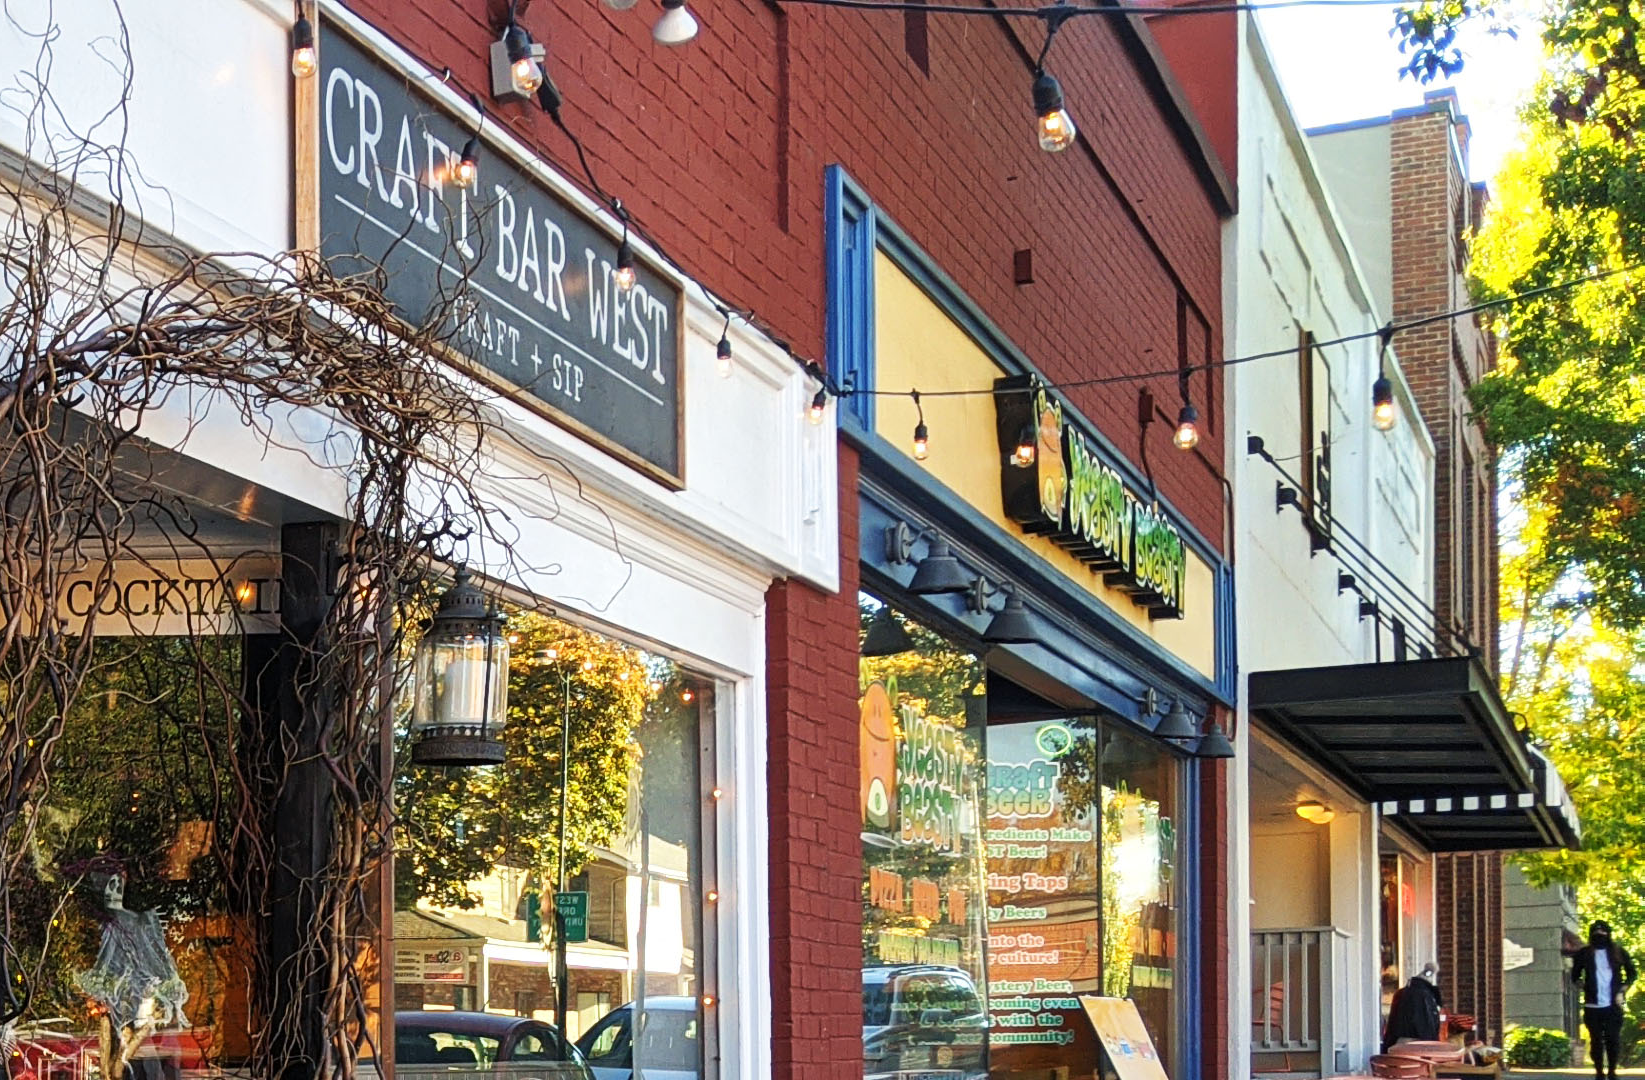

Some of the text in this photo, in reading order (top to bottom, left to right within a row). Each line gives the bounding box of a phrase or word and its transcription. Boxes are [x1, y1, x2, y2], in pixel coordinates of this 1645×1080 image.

[324, 66, 668, 385] CRAFT BAR WEST
[453, 296, 520, 367] CRAFT
[552, 353, 584, 403] SIP
[1051, 828, 1092, 841] Make
[1007, 845, 1047, 858] Beer!
[1023, 873, 1068, 891] Taps
[1004, 905, 1046, 919] Beers
[1017, 933, 1045, 948] the
[998, 949, 1059, 965] culture!
[999, 1013, 1036, 1027] with
[1038, 1012, 1063, 1026] the
